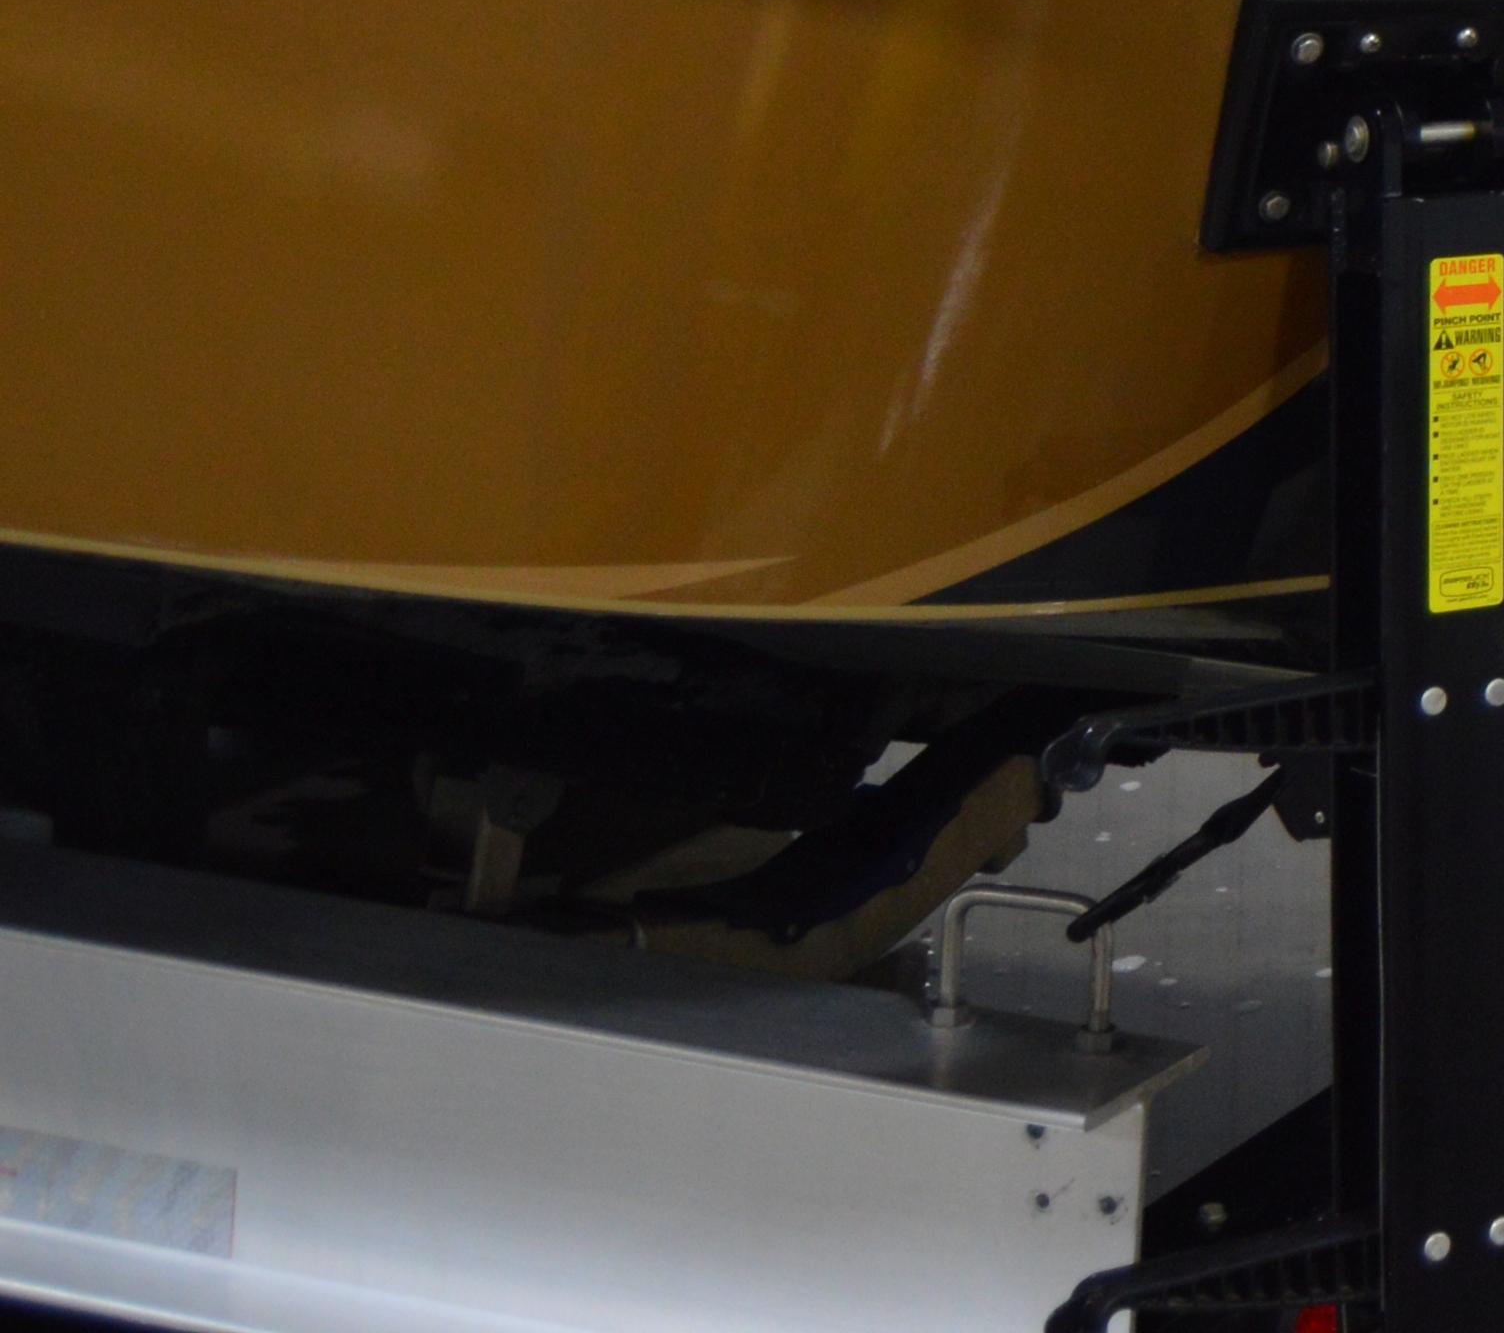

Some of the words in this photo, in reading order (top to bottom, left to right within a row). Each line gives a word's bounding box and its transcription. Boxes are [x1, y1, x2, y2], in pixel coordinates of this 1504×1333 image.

[1439, 257, 1496, 276] DANGER
[1433, 314, 1467, 326] PINCH
[1469, 312, 1502, 323] POINT
[1454, 327, 1501, 346] WARNING
